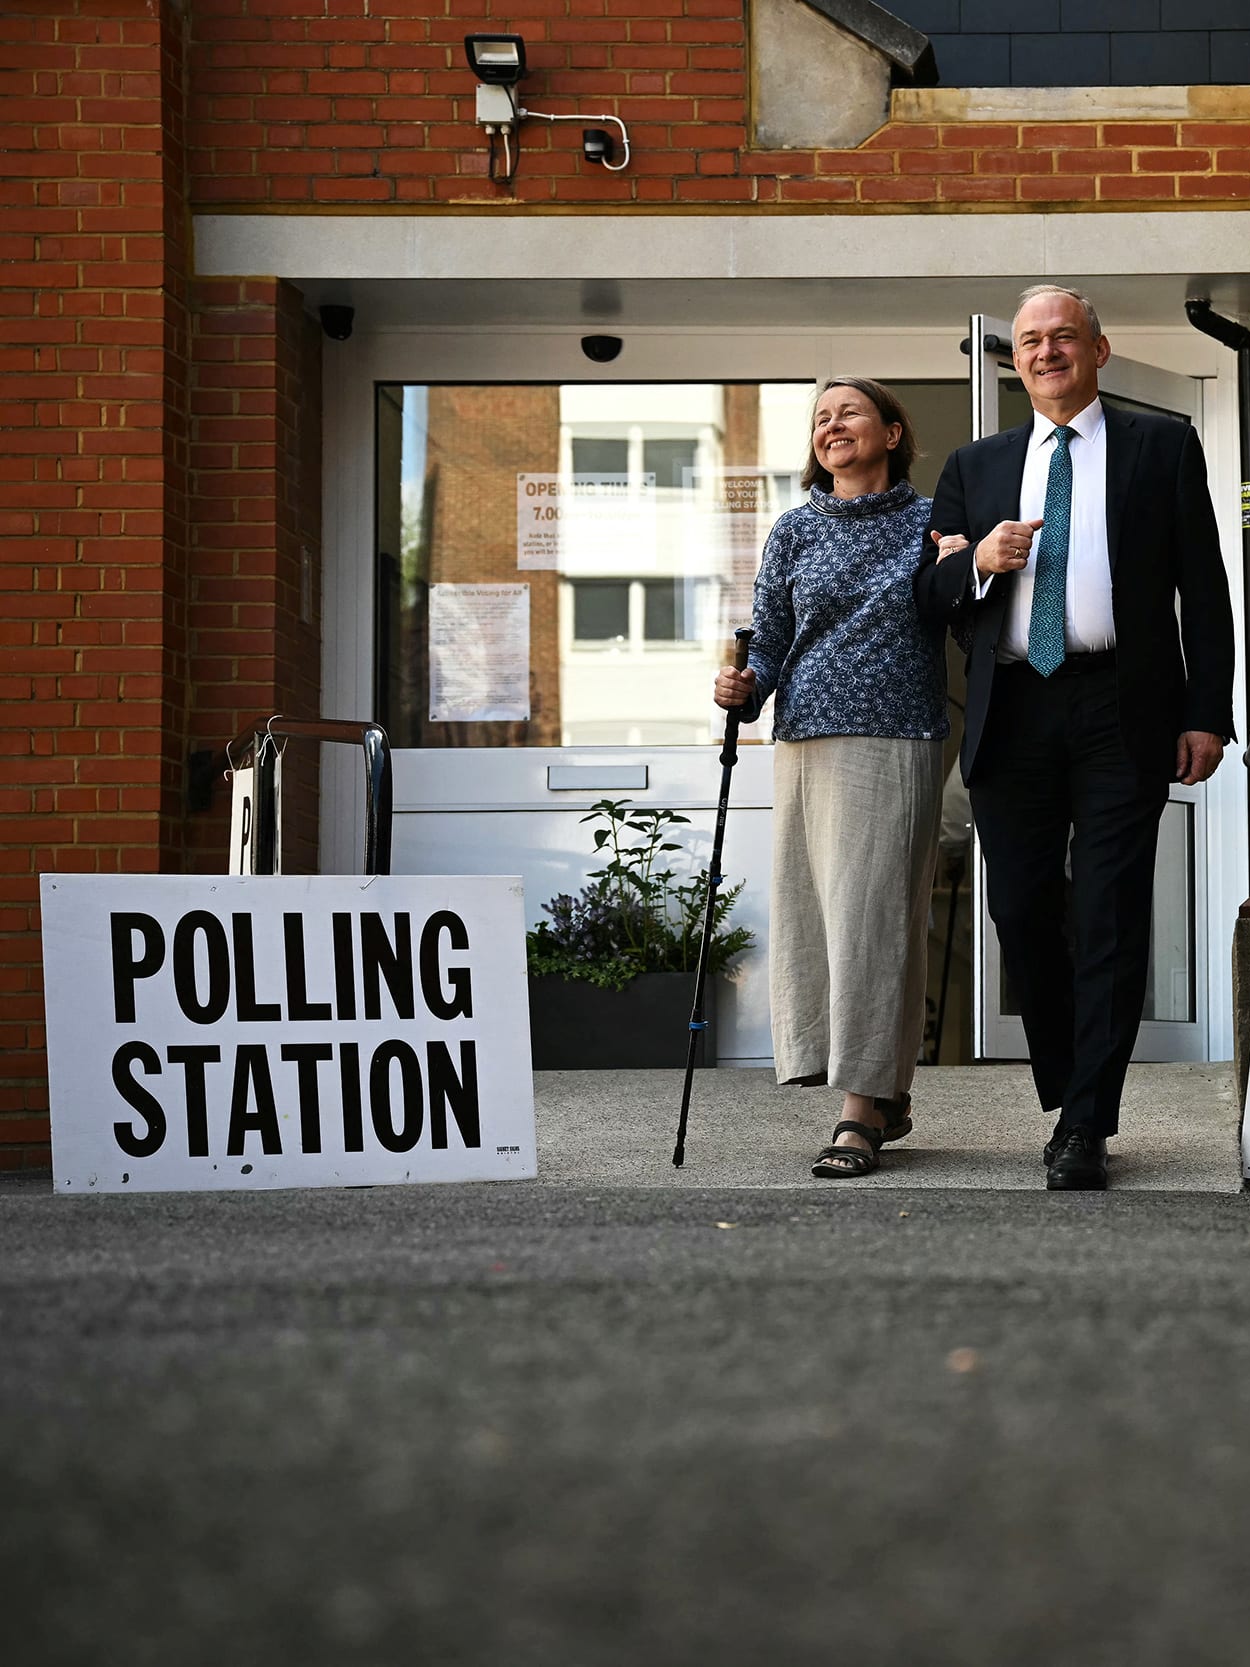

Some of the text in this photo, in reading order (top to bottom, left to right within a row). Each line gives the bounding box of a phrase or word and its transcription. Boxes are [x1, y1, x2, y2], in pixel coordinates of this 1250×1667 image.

[525, 482, 648, 496] OPENNG TIMS
[720, 480, 764, 488] WELCOME
[533, 507, 566, 520] 7.00
[110, 909, 473, 1024] POLLING
[111, 1039, 482, 1158] STATION
